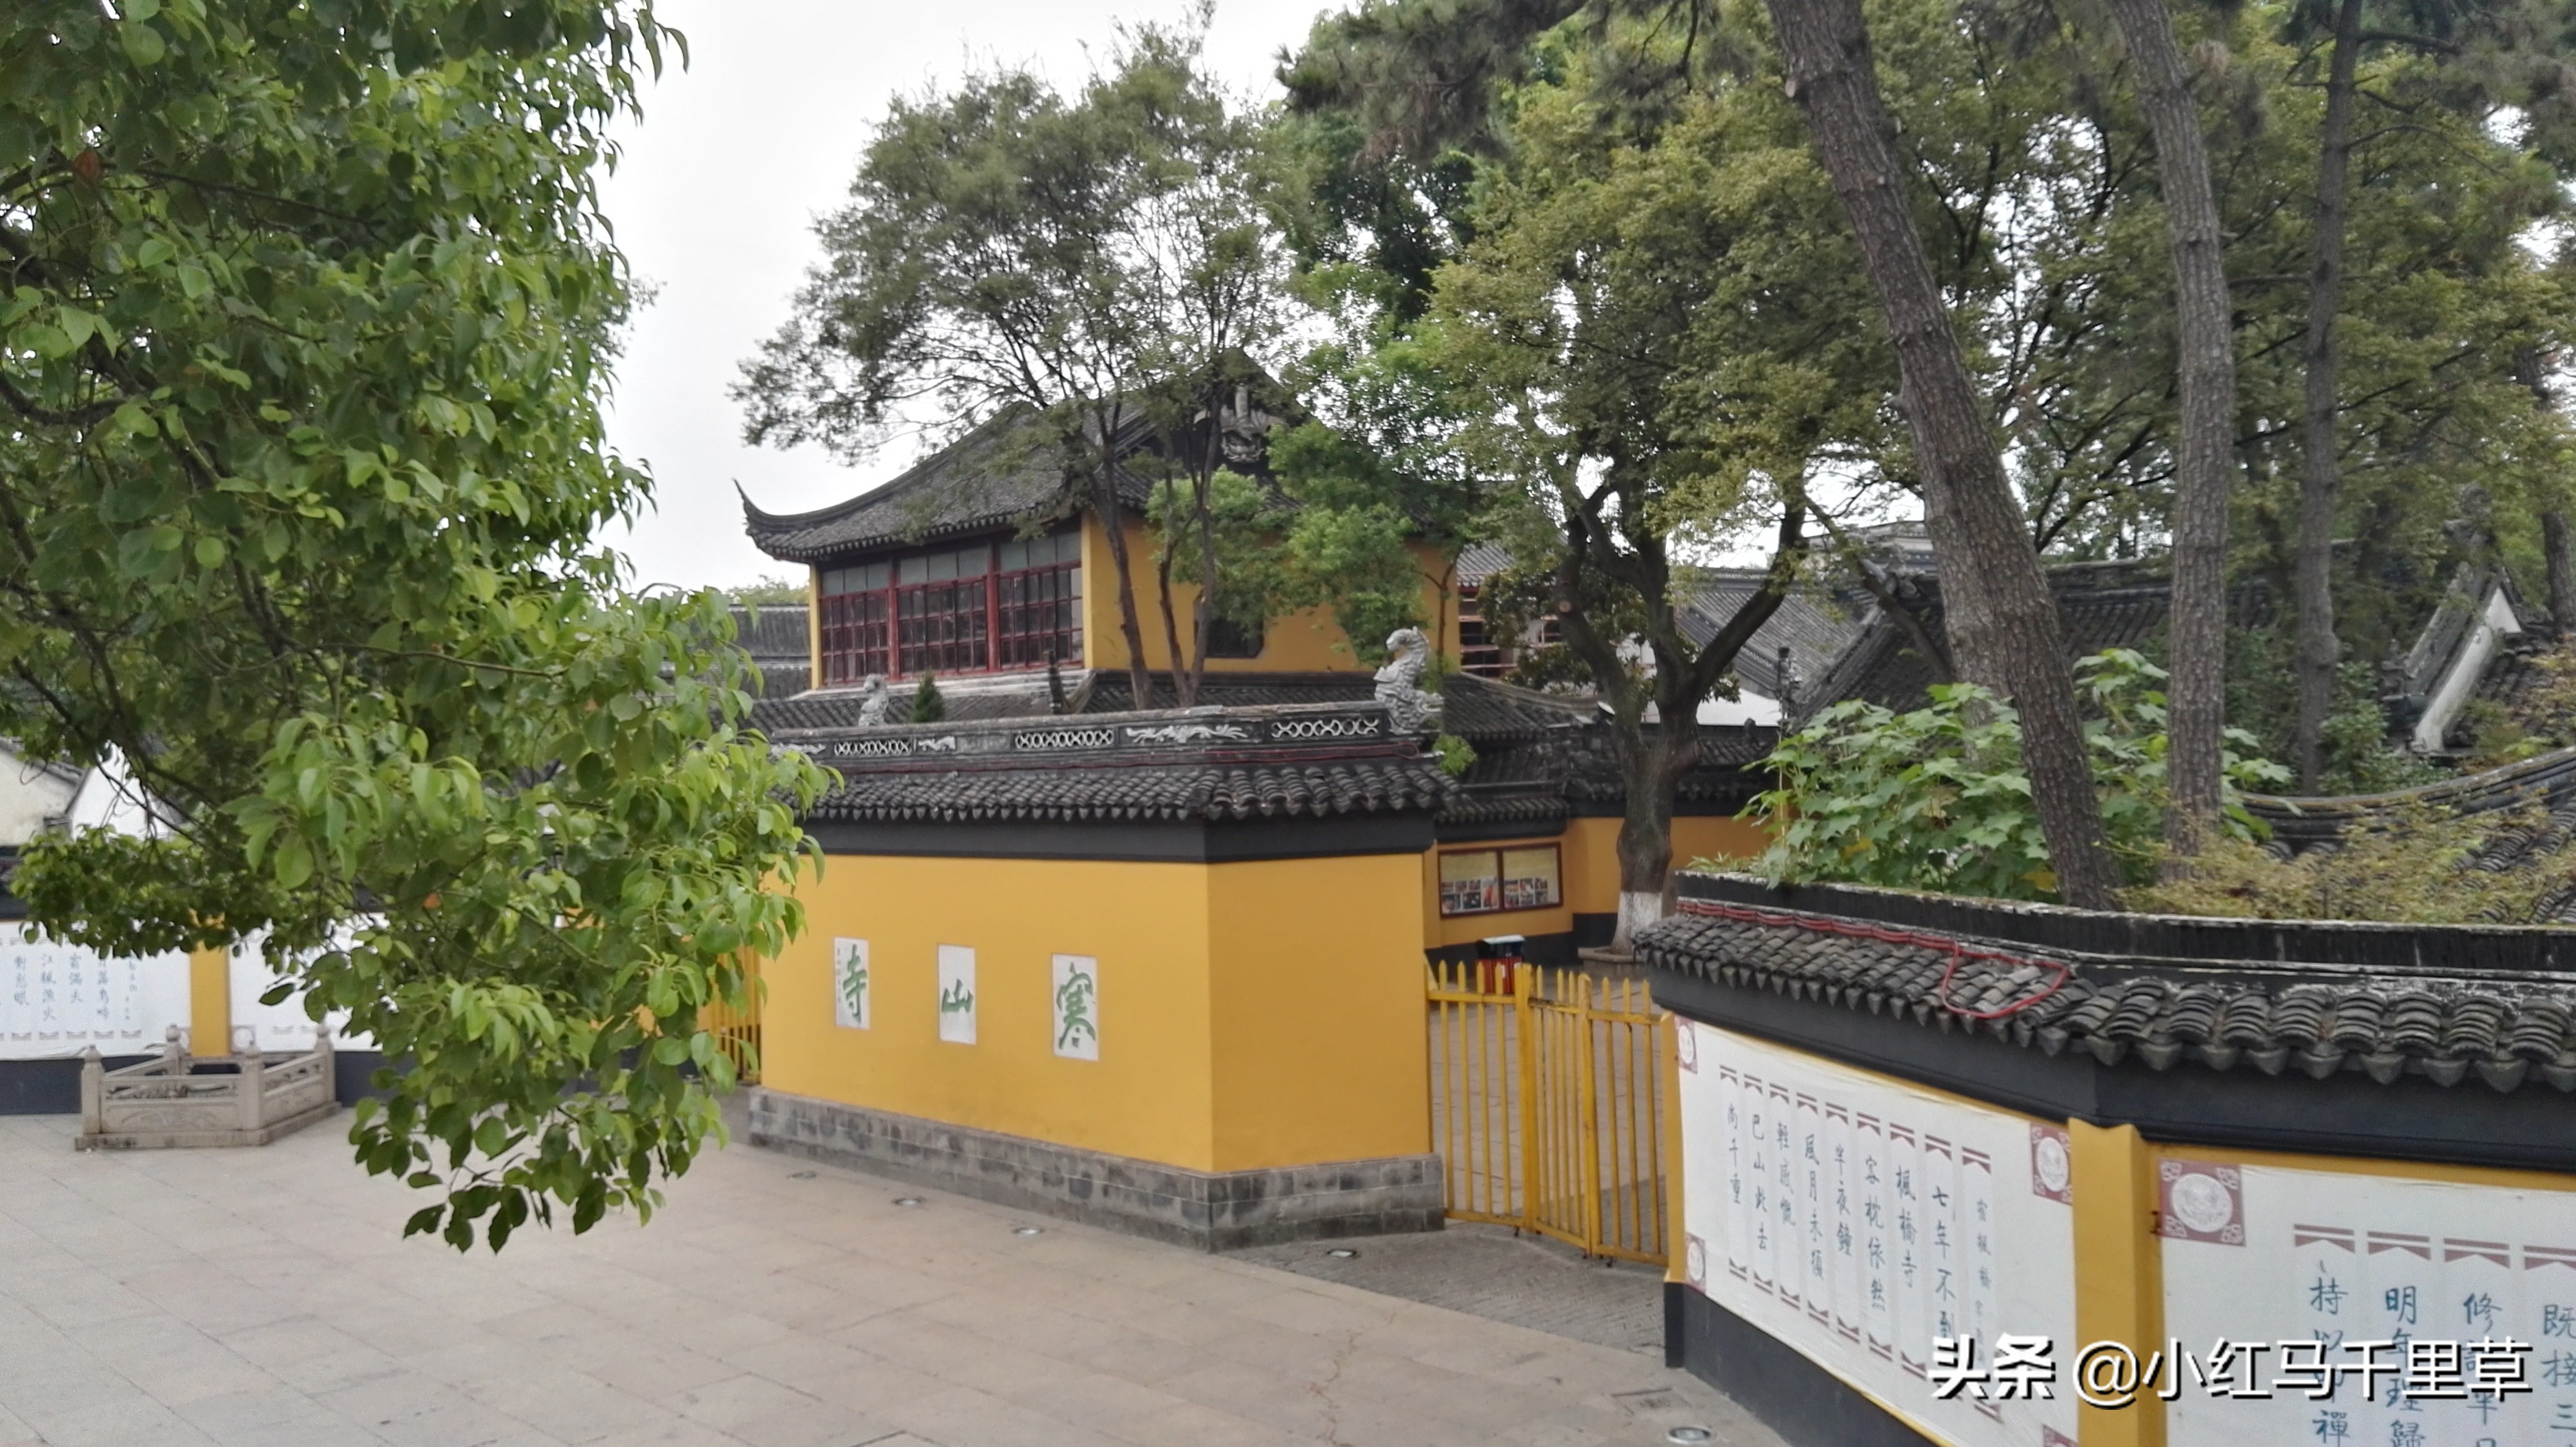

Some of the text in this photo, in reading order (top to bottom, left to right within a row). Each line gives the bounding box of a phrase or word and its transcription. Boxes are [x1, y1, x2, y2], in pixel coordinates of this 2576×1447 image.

[843, 943, 868, 1023] 寺
[941, 978, 973, 1013] 山
[1056, 962, 1096, 1049] 寒
[2308, 1277, 2351, 1447] 持以禪
